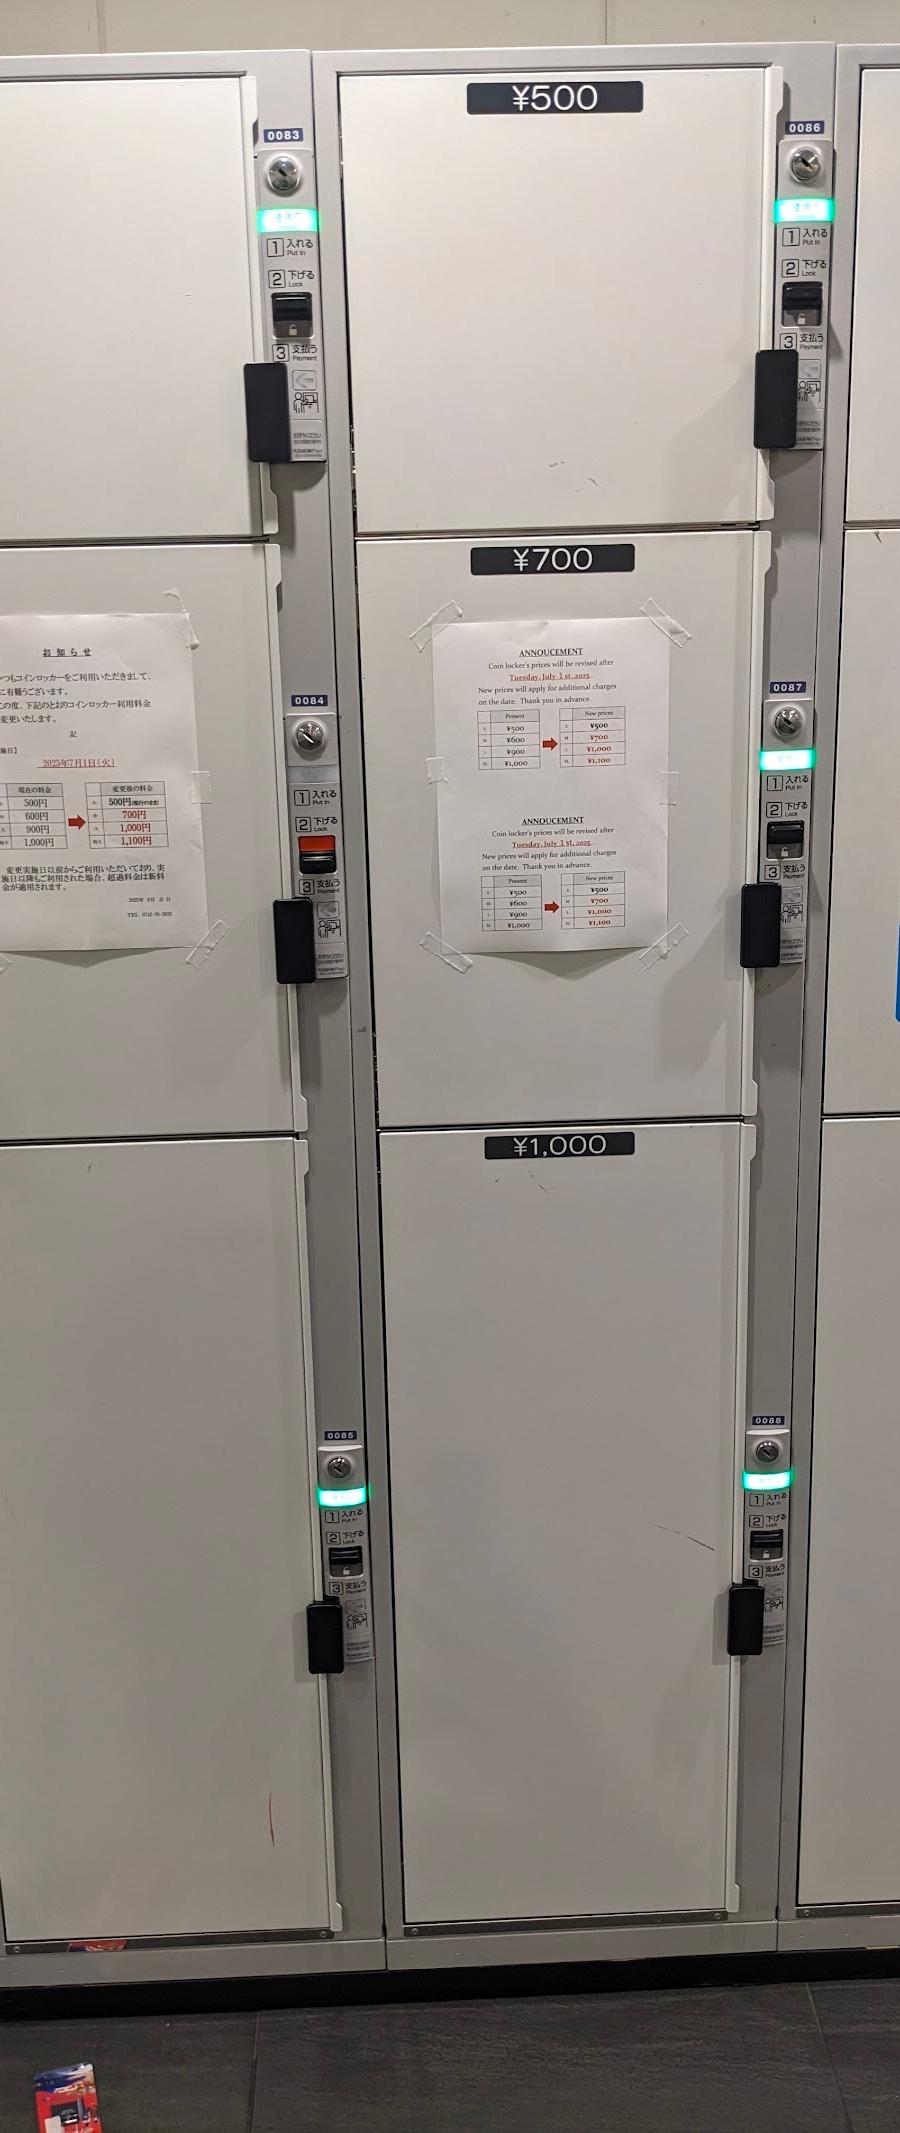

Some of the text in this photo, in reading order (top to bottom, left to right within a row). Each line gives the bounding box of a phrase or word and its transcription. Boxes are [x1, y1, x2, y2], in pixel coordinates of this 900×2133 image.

[512, 84, 598, 111] ¥500
[789, 123, 821, 133] 0086
[267, 130, 300, 141] 0083
[788, 228, 828, 244] 1 入れる
[272, 239, 314, 255] 1 入れる
[786, 260, 826, 275] 2 下げる
[272, 270, 314, 286] 2 下げる
[784, 334, 823, 349] 3 支払う
[276, 344, 318, 360] 3 支払う
[513, 547, 593, 572] ¥700
[43, 648, 92, 657] お知らせ
[519, 648, 583, 657] ANNOUCEMENT
[532, 661, 550, 670] prices
[494, 686, 513, 695] prices
[774, 684, 802, 692] 0087
[295, 697, 324, 705] 0084
[772, 776, 808, 789] 1 入れる
[299, 793, 304, 804] 1
[24, 799, 47, 808] 500円
[770, 802, 808, 815] 2 下げる
[25, 812, 48, 821] 600円
[122, 810, 146, 819] 700円
[299, 819, 308, 830] 2
[522, 817, 584, 826] ANNOUCEMENT
[26, 825, 49, 834] 900円
[120, 823, 151, 832] 1,000円
[534, 829, 552, 838] prices
[24, 838, 54, 847] 1,000円
[122, 836, 152, 845] 1,100円
[498, 852, 516, 861] prices
[768, 867, 777, 878] 3
[302, 882, 311, 893] 3
[591, 887, 608, 895] ¥500
[513, 1134, 607, 1157] ¥1,000
[754, 1496, 759, 1504] 1
[330, 1513, 334, 1521] 1
[752, 1517, 760, 1526] 2
[329, 1534, 337, 1542] 2
[752, 1567, 759, 1576] 3
[332, 1584, 340, 1593] 3
